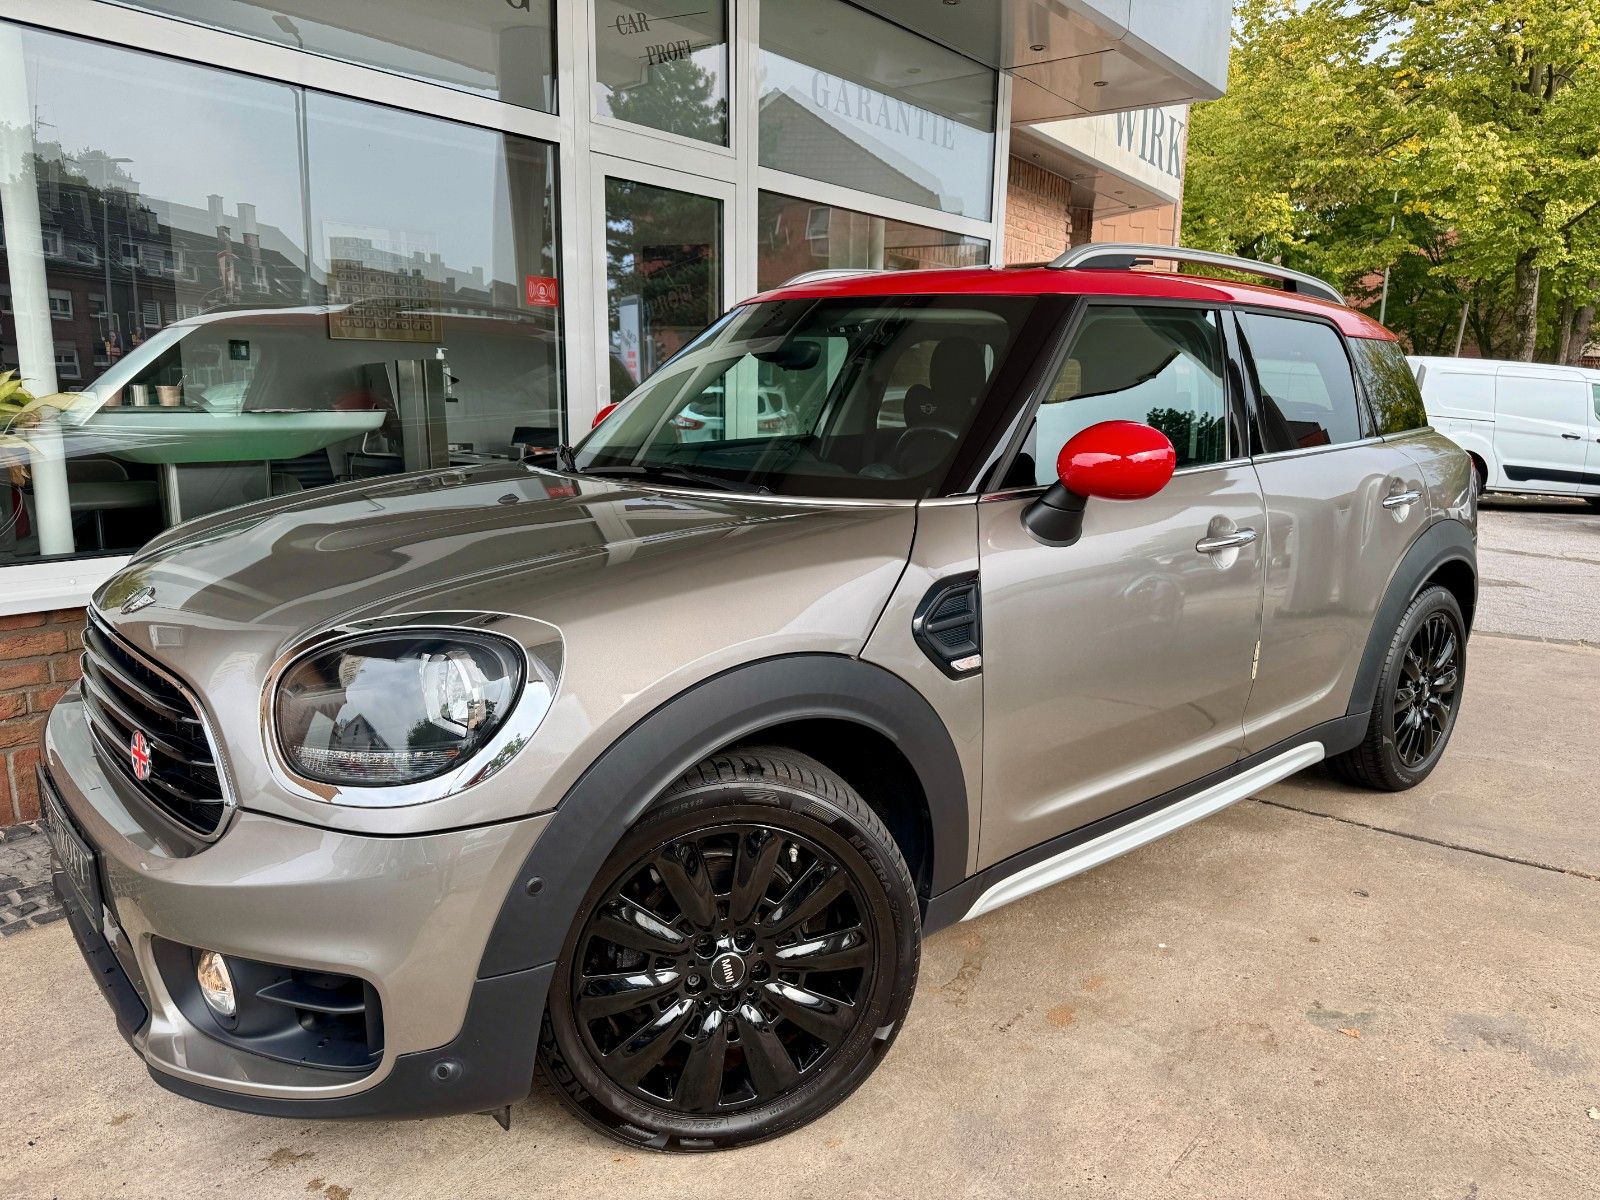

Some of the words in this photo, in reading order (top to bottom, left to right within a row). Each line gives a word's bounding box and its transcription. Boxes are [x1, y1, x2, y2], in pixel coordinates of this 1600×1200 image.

[615, 12, 650, 35] CAR
[645, 39, 692, 65] PROFI
[811, 70, 956, 151] GARANTIE
[1116, 107, 1184, 180] WIRK
[721, 958, 735, 983] MINI
